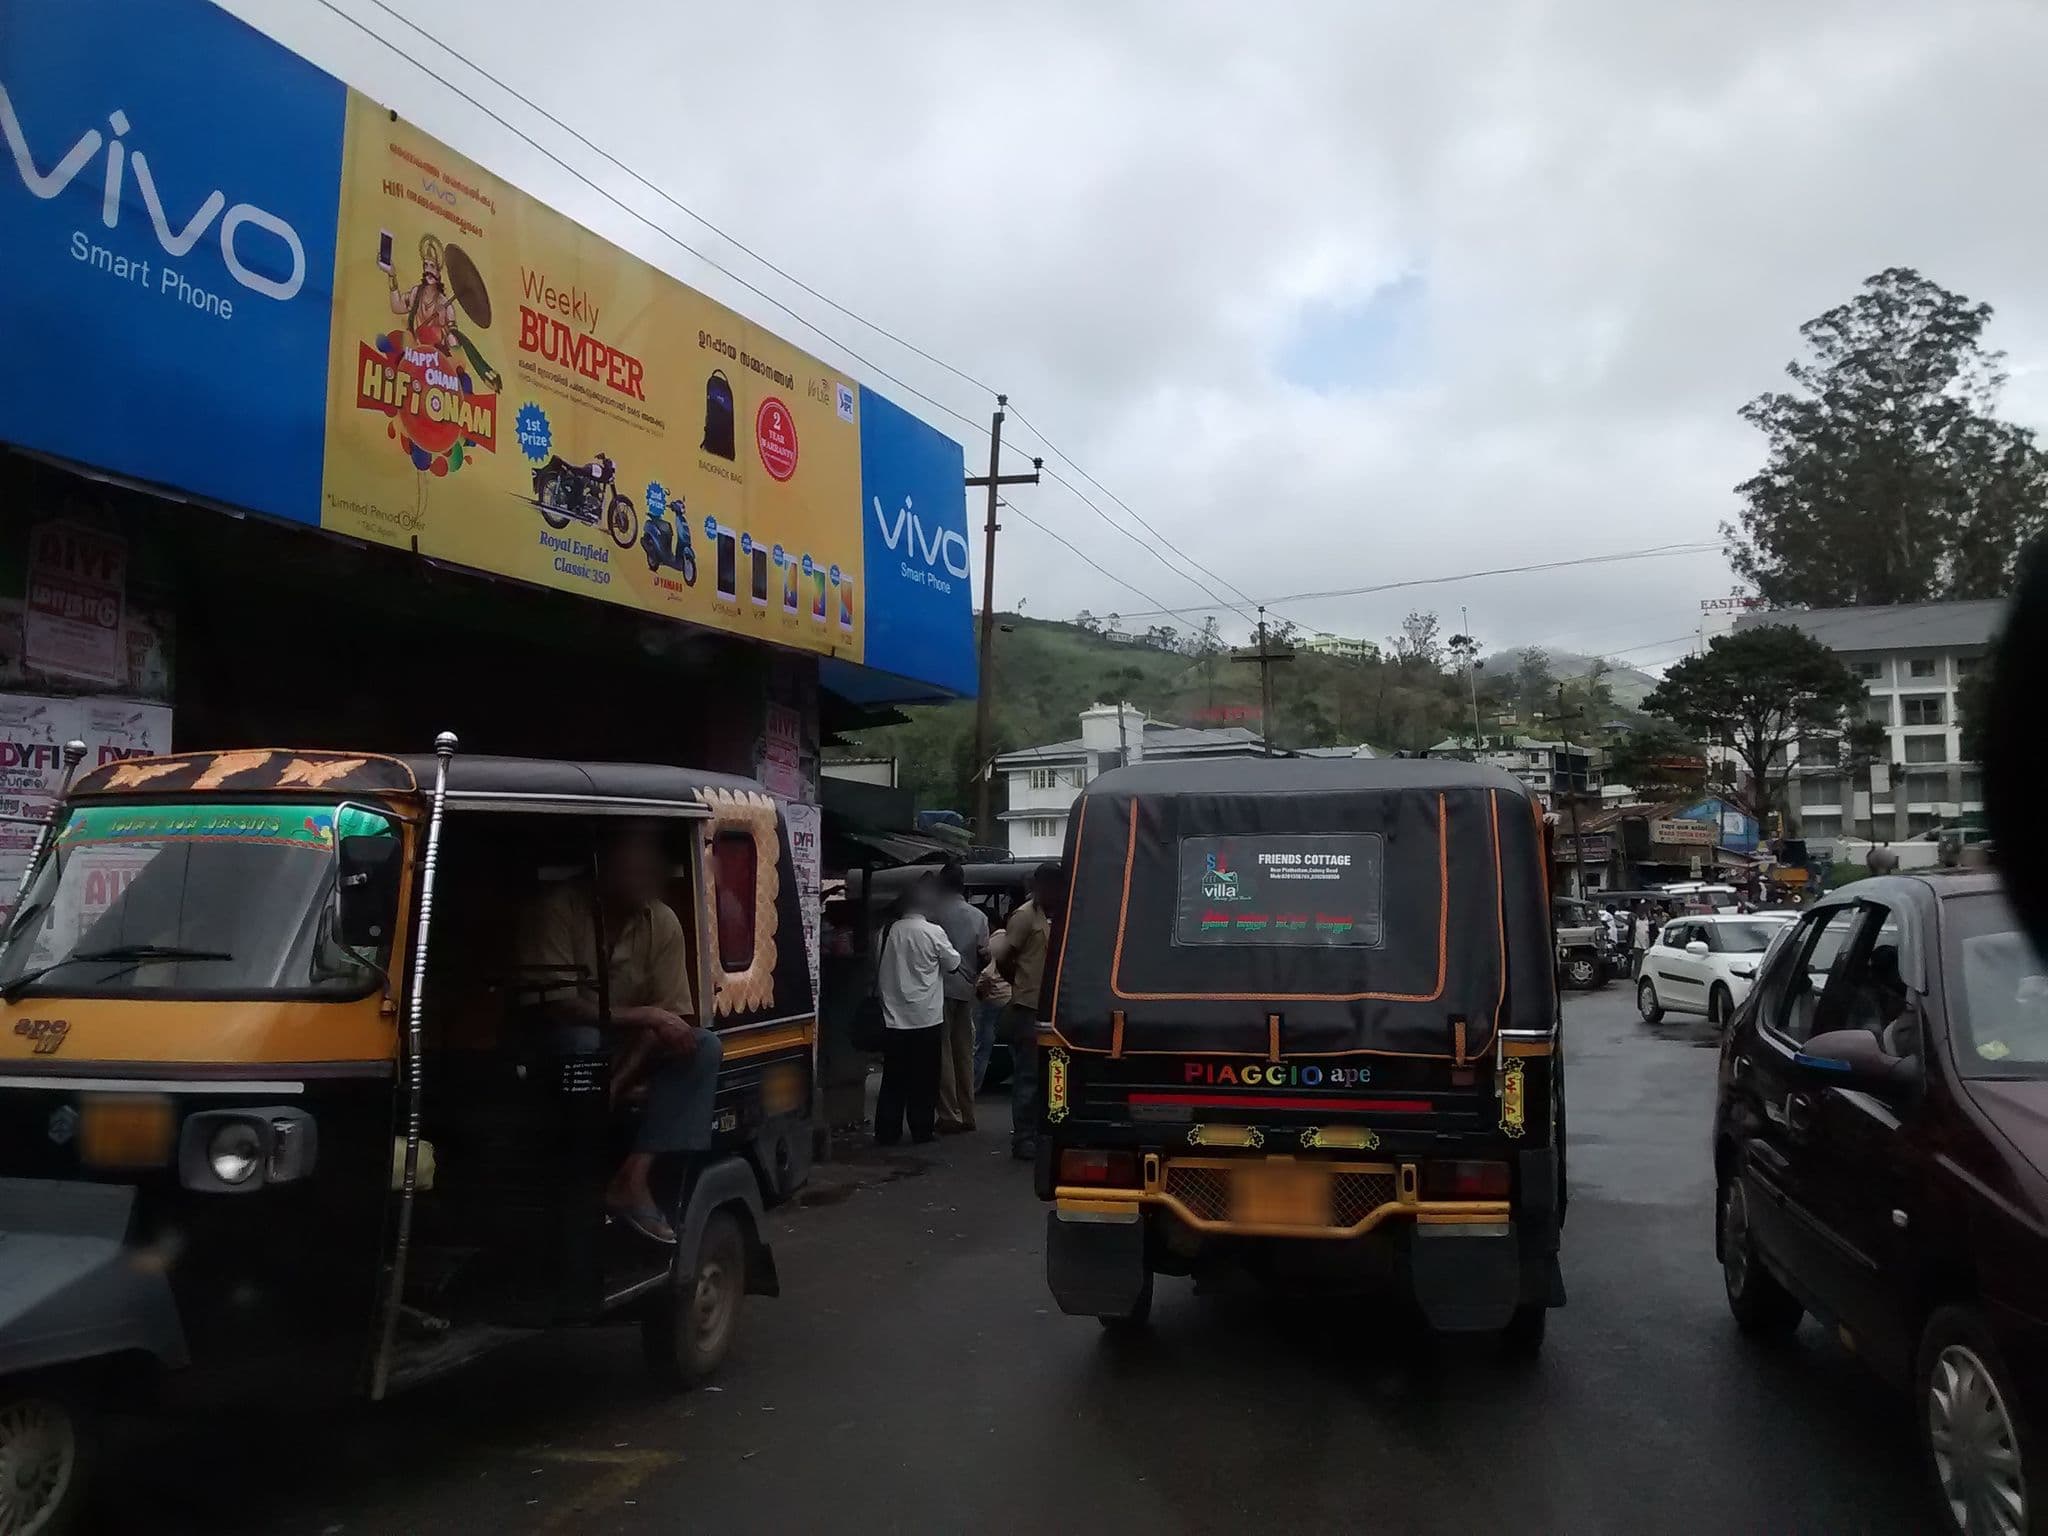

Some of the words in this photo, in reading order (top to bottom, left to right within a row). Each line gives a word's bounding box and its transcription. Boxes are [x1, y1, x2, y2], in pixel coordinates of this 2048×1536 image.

[0, 83, 305, 300] vivo
[70, 231, 150, 288] Smart
[161, 268, 233, 320] Phone
[521, 266, 599, 334] Weekly
[405, 347, 439, 367] HAPPY
[519, 304, 646, 402] BUMPER
[425, 368, 458, 392] ONAM
[425, 387, 492, 438] ONAM
[525, 418, 542, 432] 1st
[773, 412, 781, 430] 2
[521, 432, 548, 447] Prize
[760, 437, 794, 459] WARRANTY
[769, 430, 785, 444] YEAR
[540, 531, 571, 554] Royal
[572, 541, 609, 563] Enfield
[873, 495, 969, 579] vivo
[554, 557, 590, 578] Classic
[591, 569, 611, 585] 350
[900, 561, 925, 585] Smart
[927, 572, 951, 595] Phone
[0, 742, 60, 770] DYFI
[98, 745, 154, 768] DY
[1258, 853, 1302, 865] FRIENDS
[1304, 854, 1351, 866] COTTAGE
[1204, 883, 1237, 898] villa
[1183, 1062, 1322, 1086] PIAGGIO
[1330, 1065, 1371, 1088] ape
